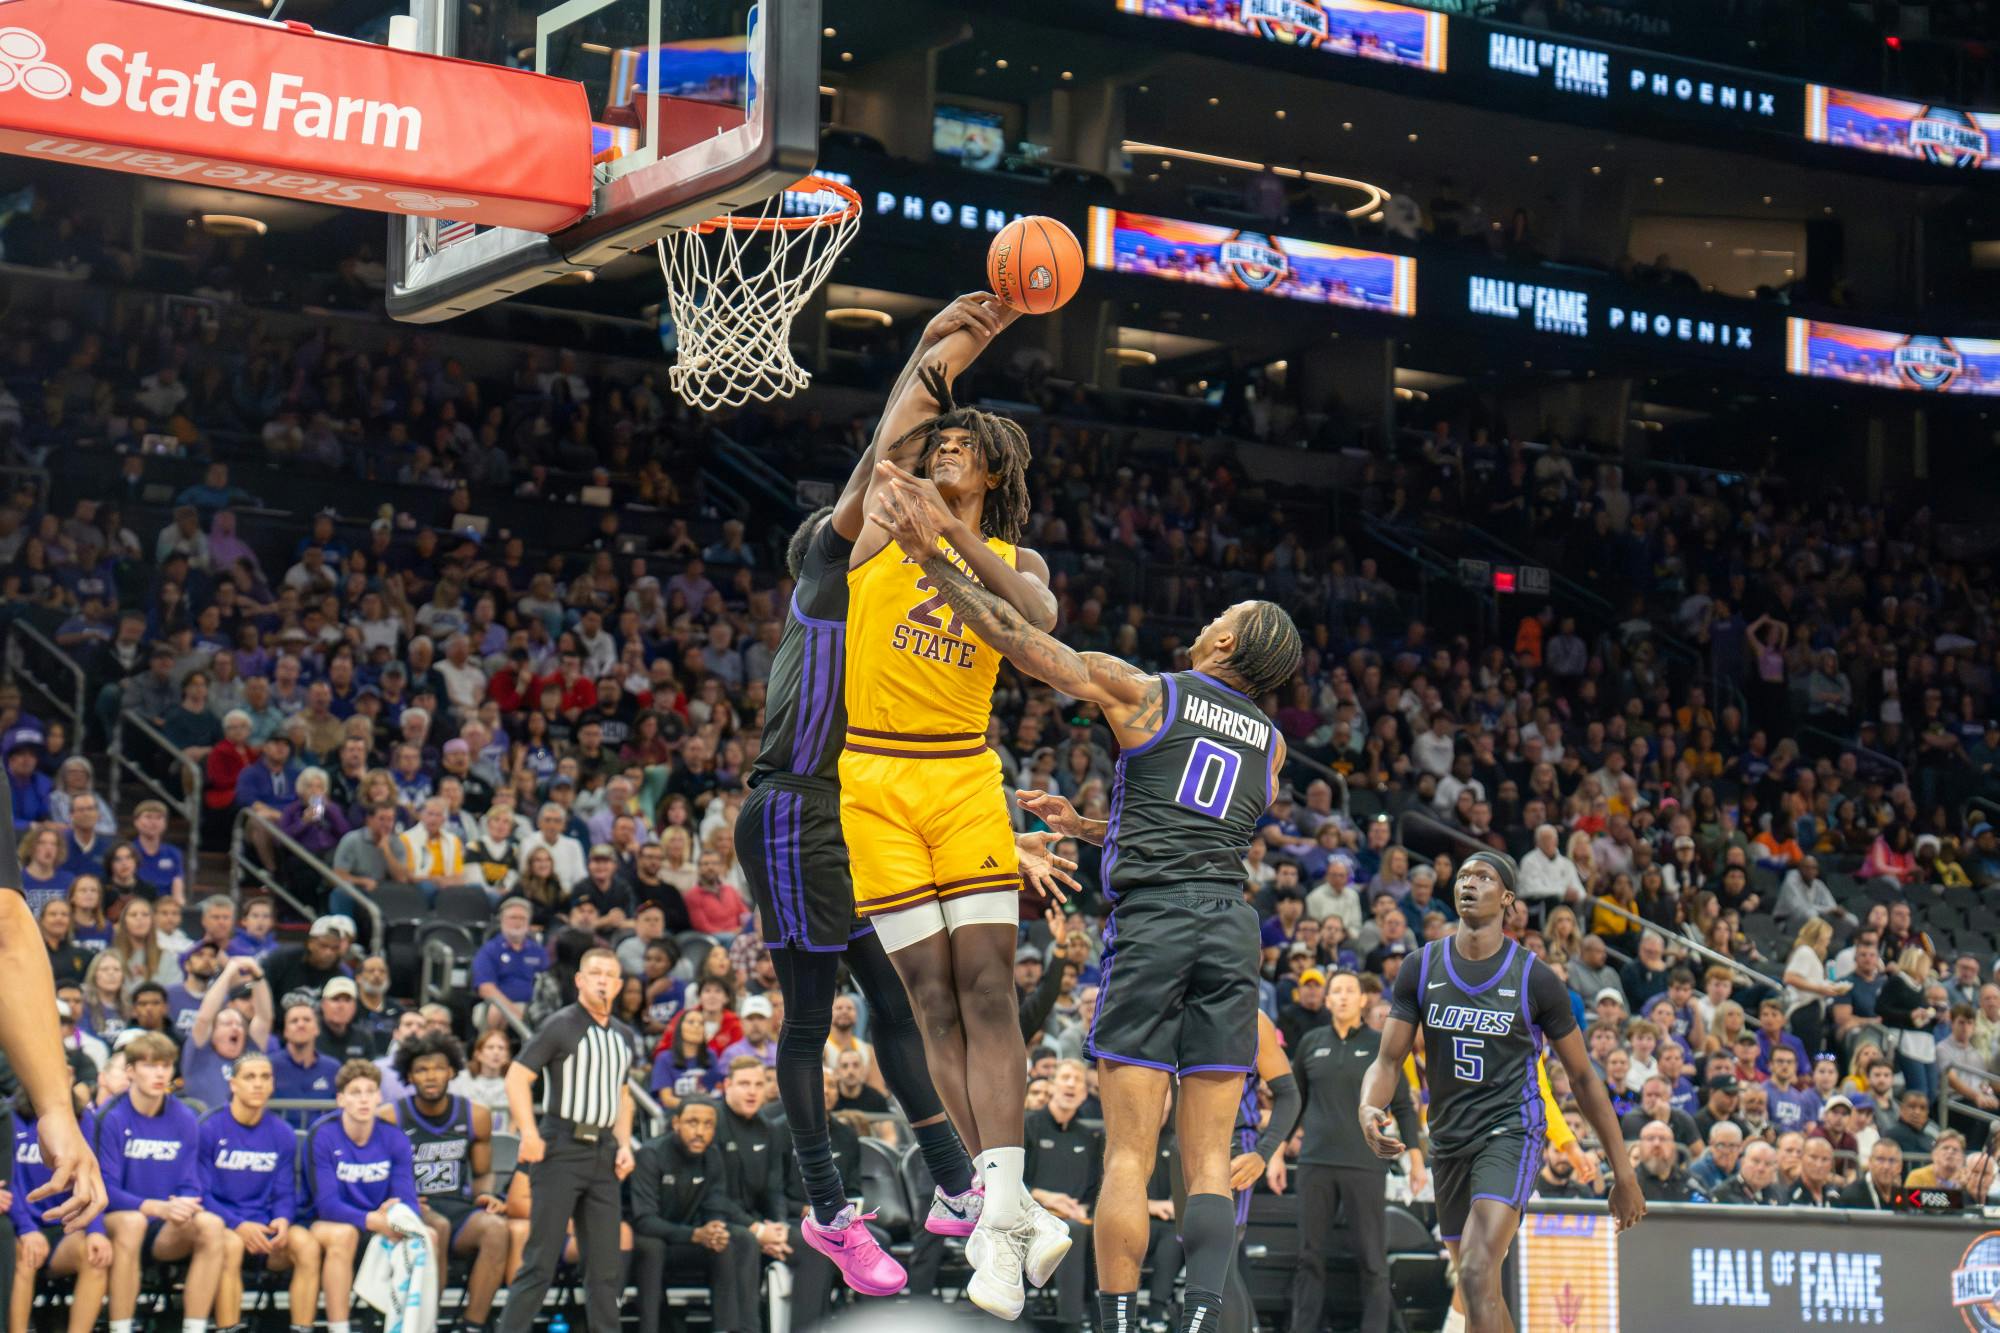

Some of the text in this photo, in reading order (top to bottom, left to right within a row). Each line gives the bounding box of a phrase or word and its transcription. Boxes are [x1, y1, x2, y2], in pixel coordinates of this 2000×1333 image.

[1489, 32, 1609, 87] HALL OF FAME
[81, 43, 423, 151] State Farm
[1630, 69, 1775, 116] PHOENIX
[1469, 276, 1588, 325] HALL OF FAME
[1609, 307, 1753, 350] PHOENIX
[892, 624, 977, 669] STATE
[1183, 694, 1270, 752] HARRISON
[1175, 736, 1242, 820] 0
[1427, 1003, 1515, 1036] LOPES
[1452, 1036, 1485, 1083] 5
[124, 1138, 182, 1161] LOPES
[214, 1148, 278, 1172] LOPES
[414, 1160, 460, 1195] 23
[1692, 1247, 1883, 1310] HALL OF FAME
[1957, 1270, 1992, 1298] HALL
[1802, 1308, 1885, 1324] SERIES
